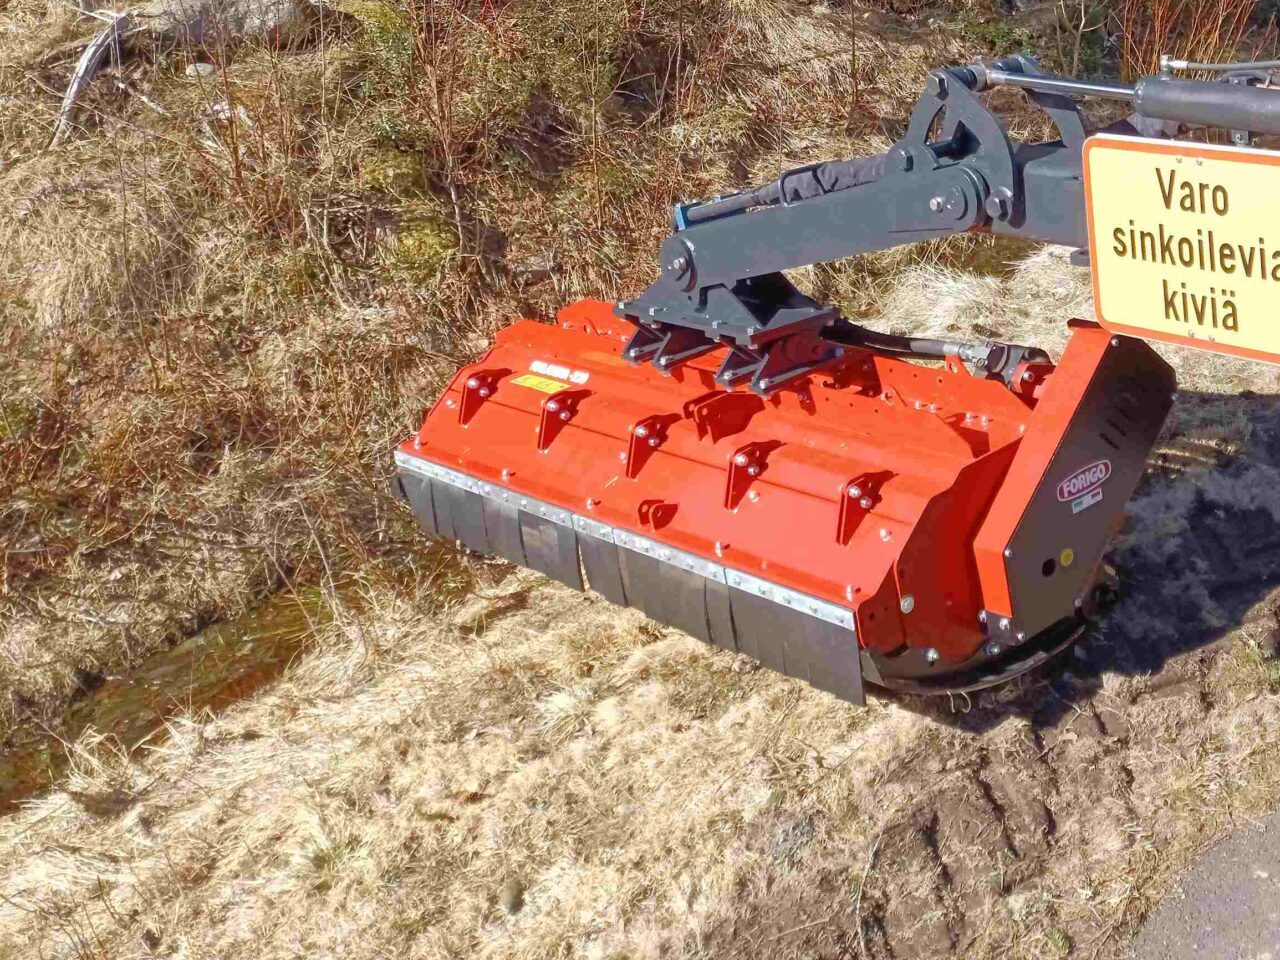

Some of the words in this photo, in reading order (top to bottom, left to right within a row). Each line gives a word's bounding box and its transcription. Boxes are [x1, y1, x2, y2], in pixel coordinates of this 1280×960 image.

[1155, 167, 1230, 216] Varo
[1162, 279, 1239, 332] kiviä
[1062, 463, 1106, 498] FORIGO
